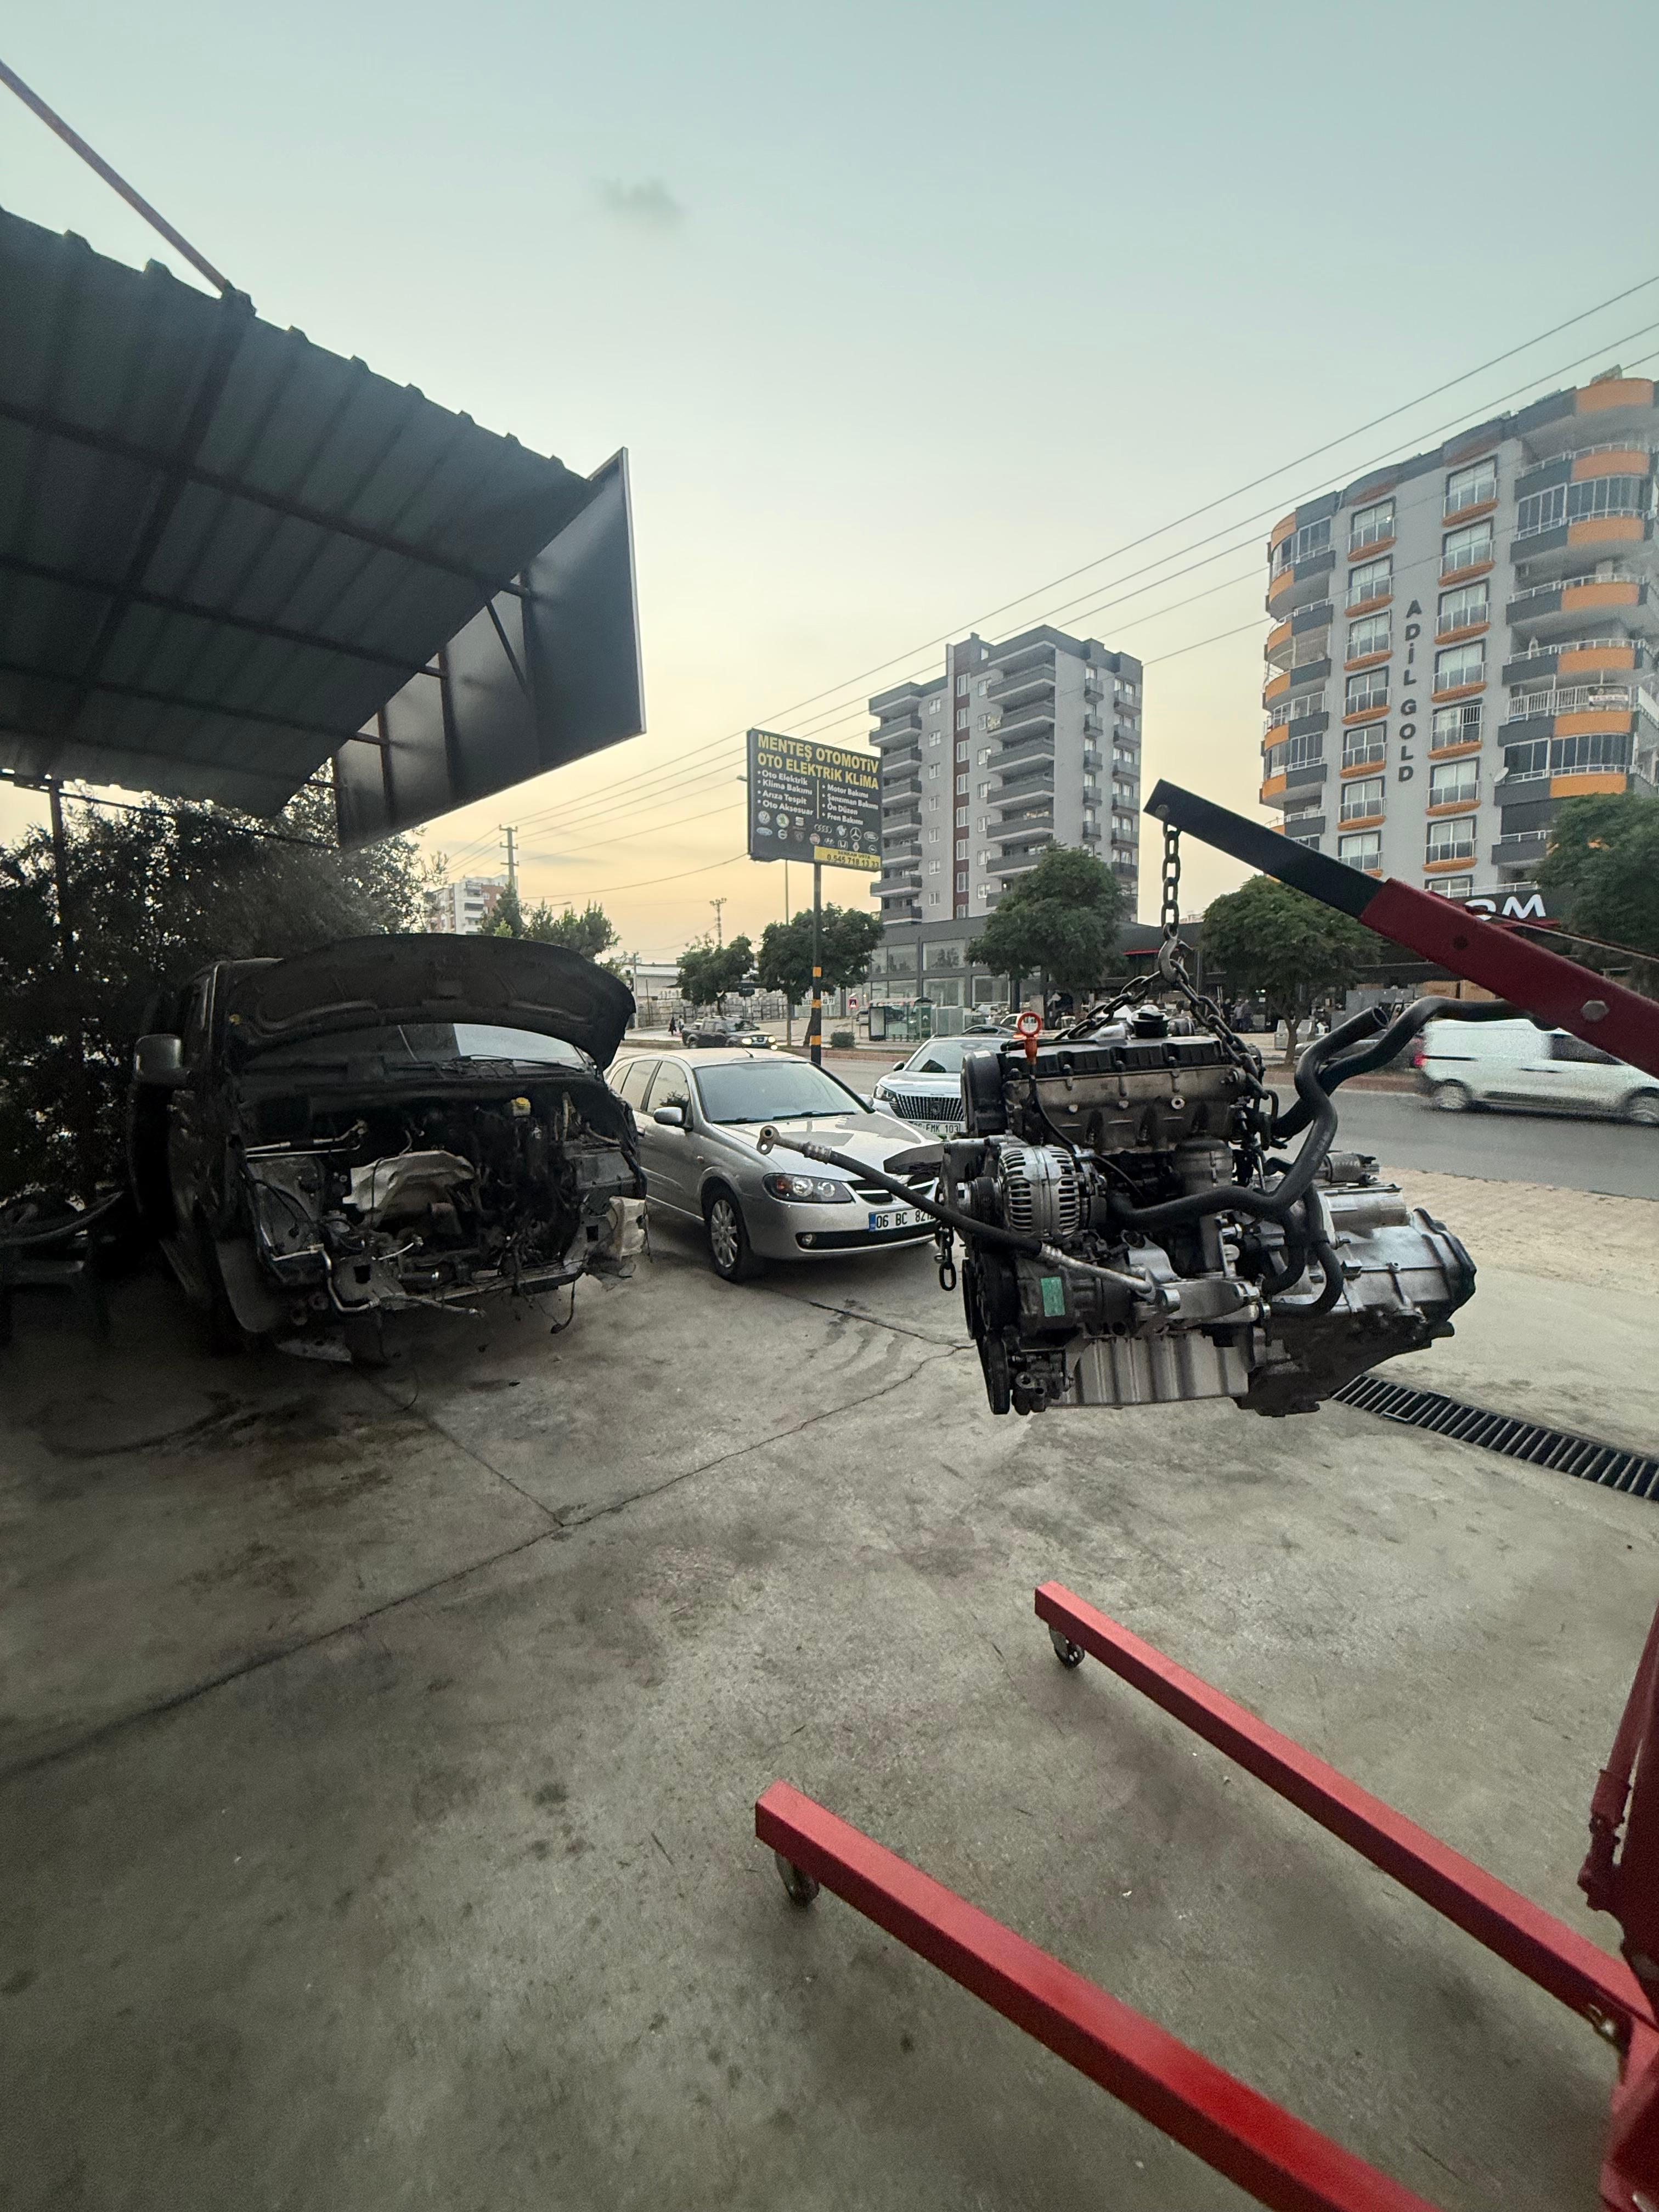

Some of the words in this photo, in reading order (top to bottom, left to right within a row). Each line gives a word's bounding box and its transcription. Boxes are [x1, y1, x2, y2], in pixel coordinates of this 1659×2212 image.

[758, 733, 812, 761] MENTEŞ
[1398, 698, 1417, 782] GOLD
[758, 752, 783, 769] OTO
[761, 769, 777, 779] Oto
[778, 772, 808, 786] Elektrik
[762, 778, 785, 790] Klima
[827, 783, 847, 794] Motor
[784, 793, 807, 805] Tespit
[762, 799, 778, 809] Oto
[779, 803, 814, 816] Aksesuar
[838, 804, 858, 815] Düzen
[827, 812, 841, 821] Fren
[876, 1215, 889, 1228] 06
[895, 1212, 907, 1226] BC
